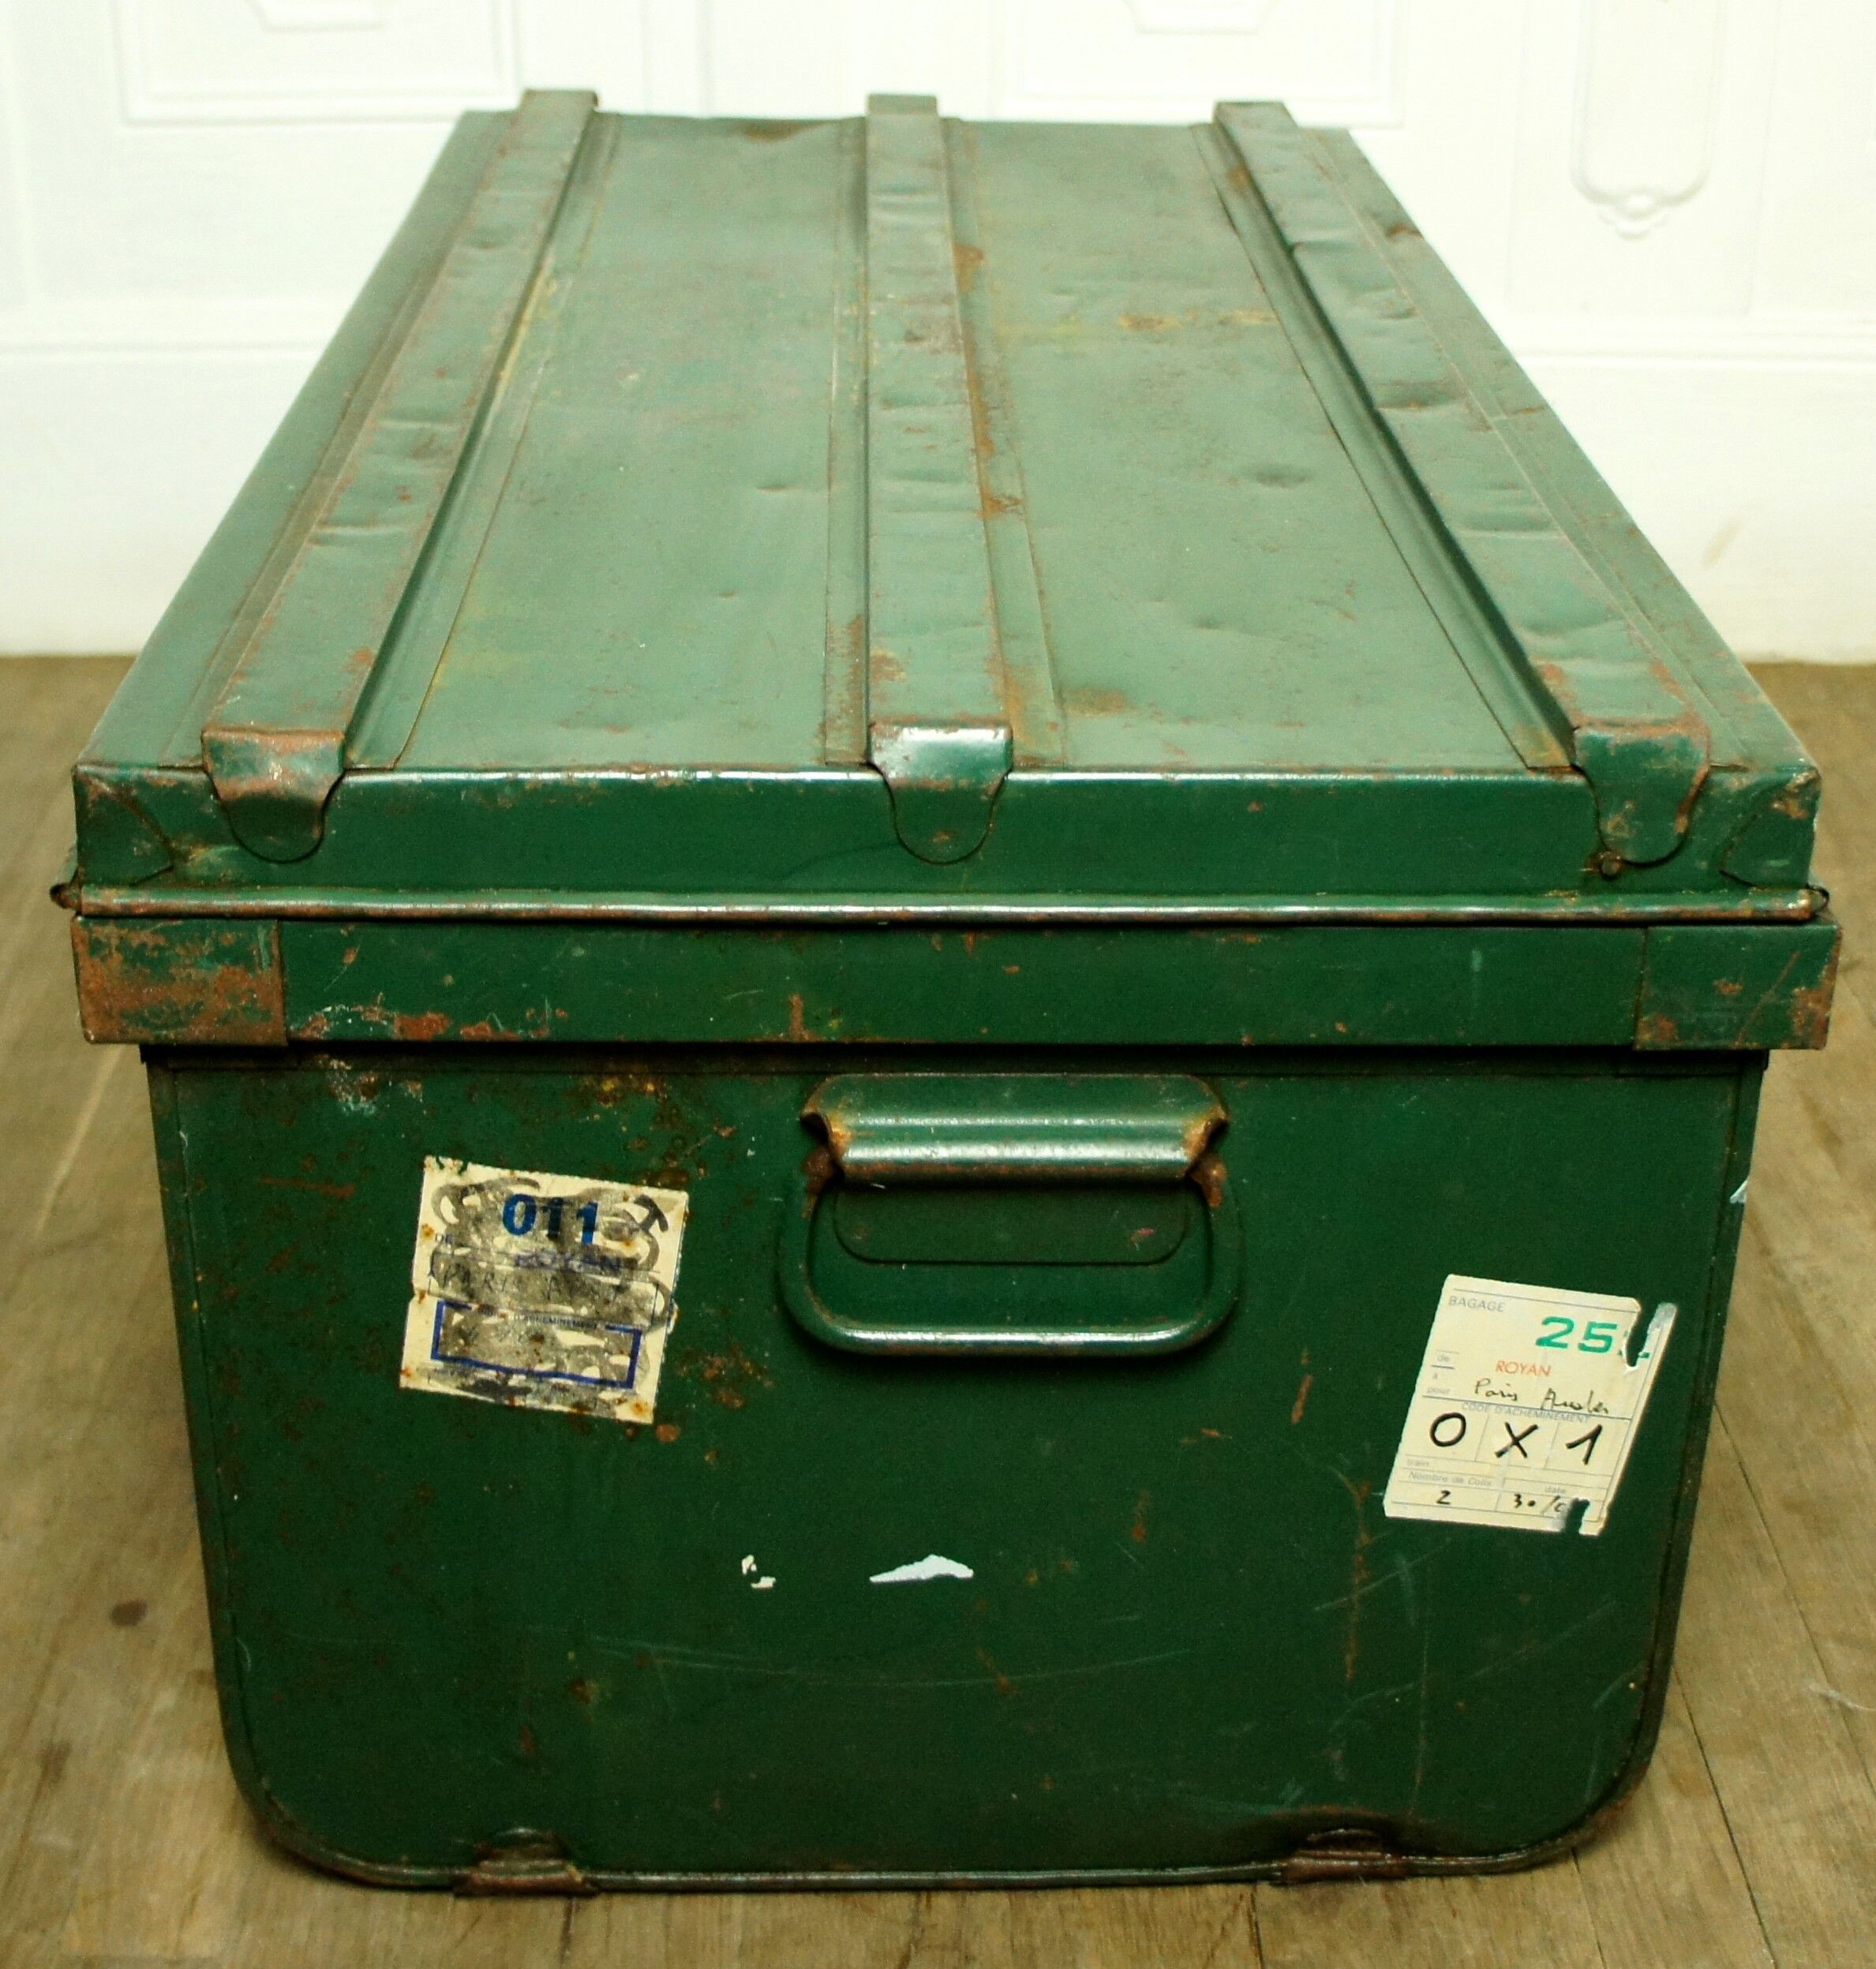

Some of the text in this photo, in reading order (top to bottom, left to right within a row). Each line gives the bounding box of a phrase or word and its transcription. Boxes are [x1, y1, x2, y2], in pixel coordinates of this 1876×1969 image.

[502, 1192, 599, 1246] 011
[1448, 1295, 1506, 1312] BAGAGE
[1535, 1316, 1650, 1359] 25
[1495, 1360, 1552, 1377] ROYAN
[1461, 1401, 1492, 1413] CODE
[1565, 1423, 1604, 1466] 1
[1408, 1470, 1449, 1483] Nombre
